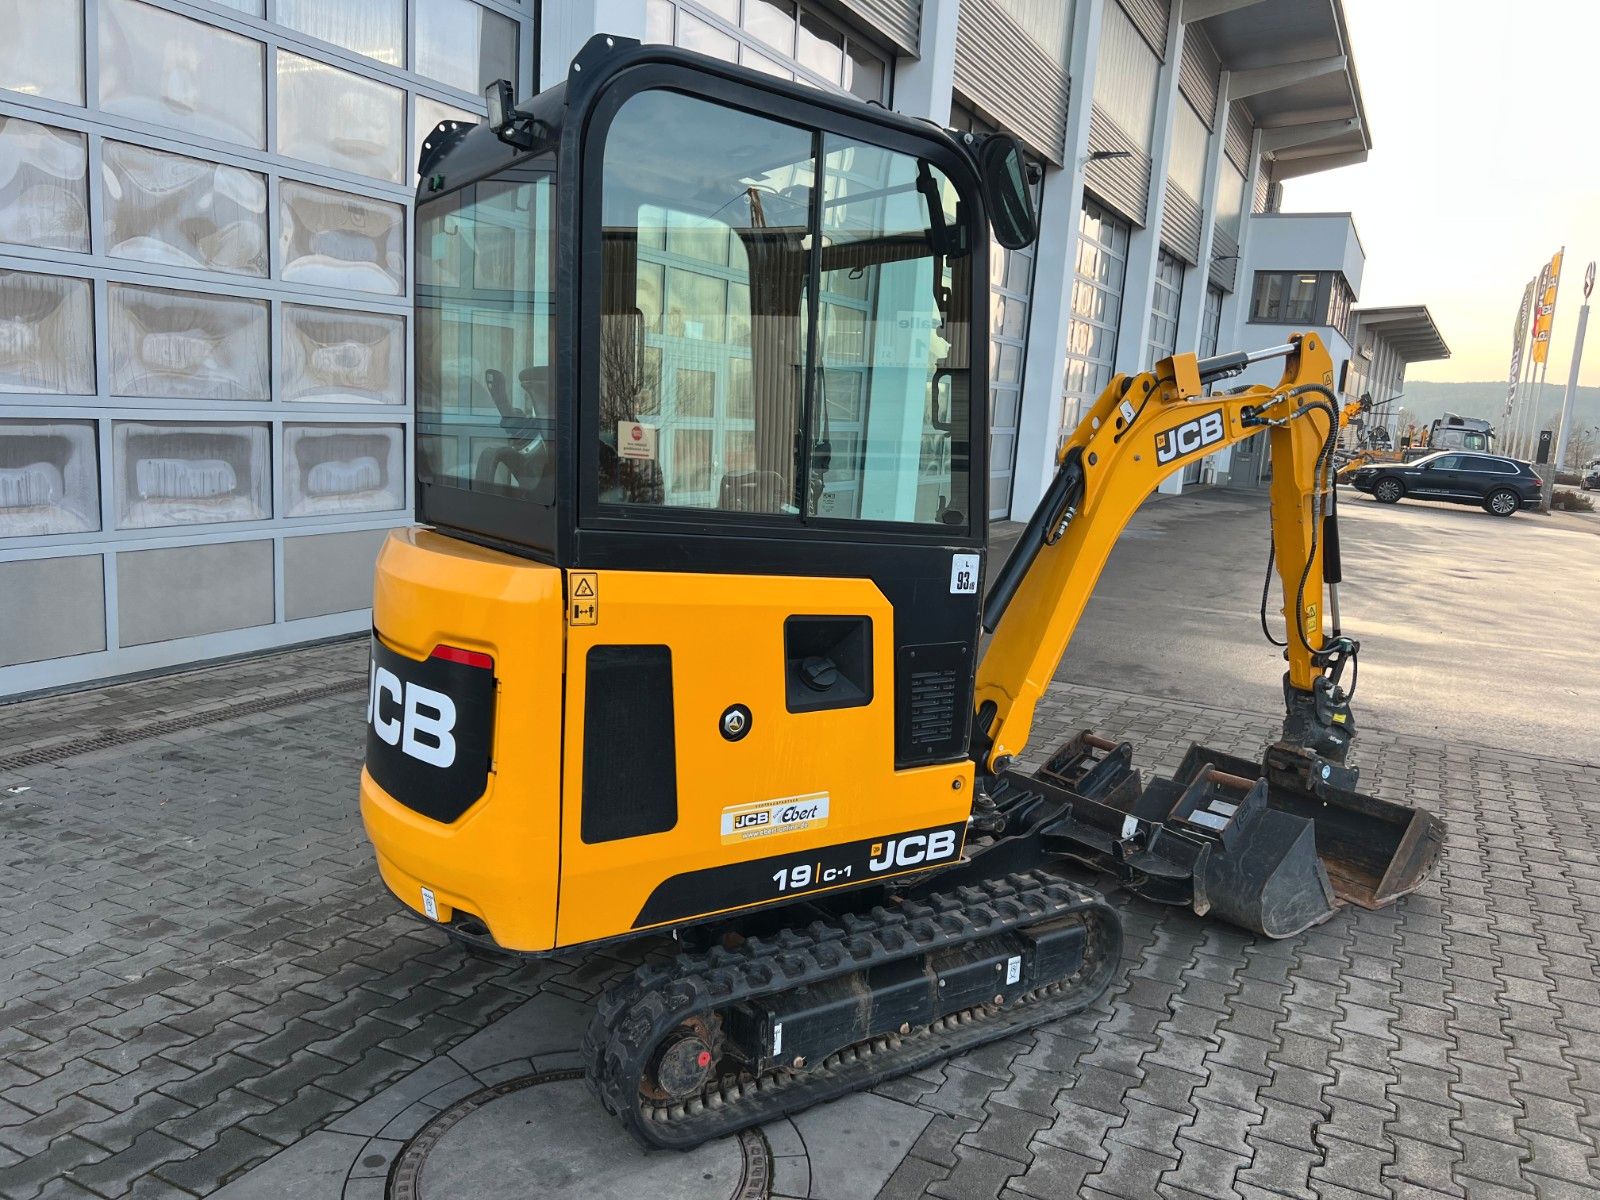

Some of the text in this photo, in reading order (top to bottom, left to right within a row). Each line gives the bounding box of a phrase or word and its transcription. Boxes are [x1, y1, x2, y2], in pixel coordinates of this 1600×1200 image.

[1158, 412, 1223, 463] JCB
[367, 659, 457, 769] JCB
[735, 812, 769, 829] JCB
[781, 805, 818, 823] Ebert
[772, 864, 812, 891] 19
[869, 829, 957, 872] JCB
